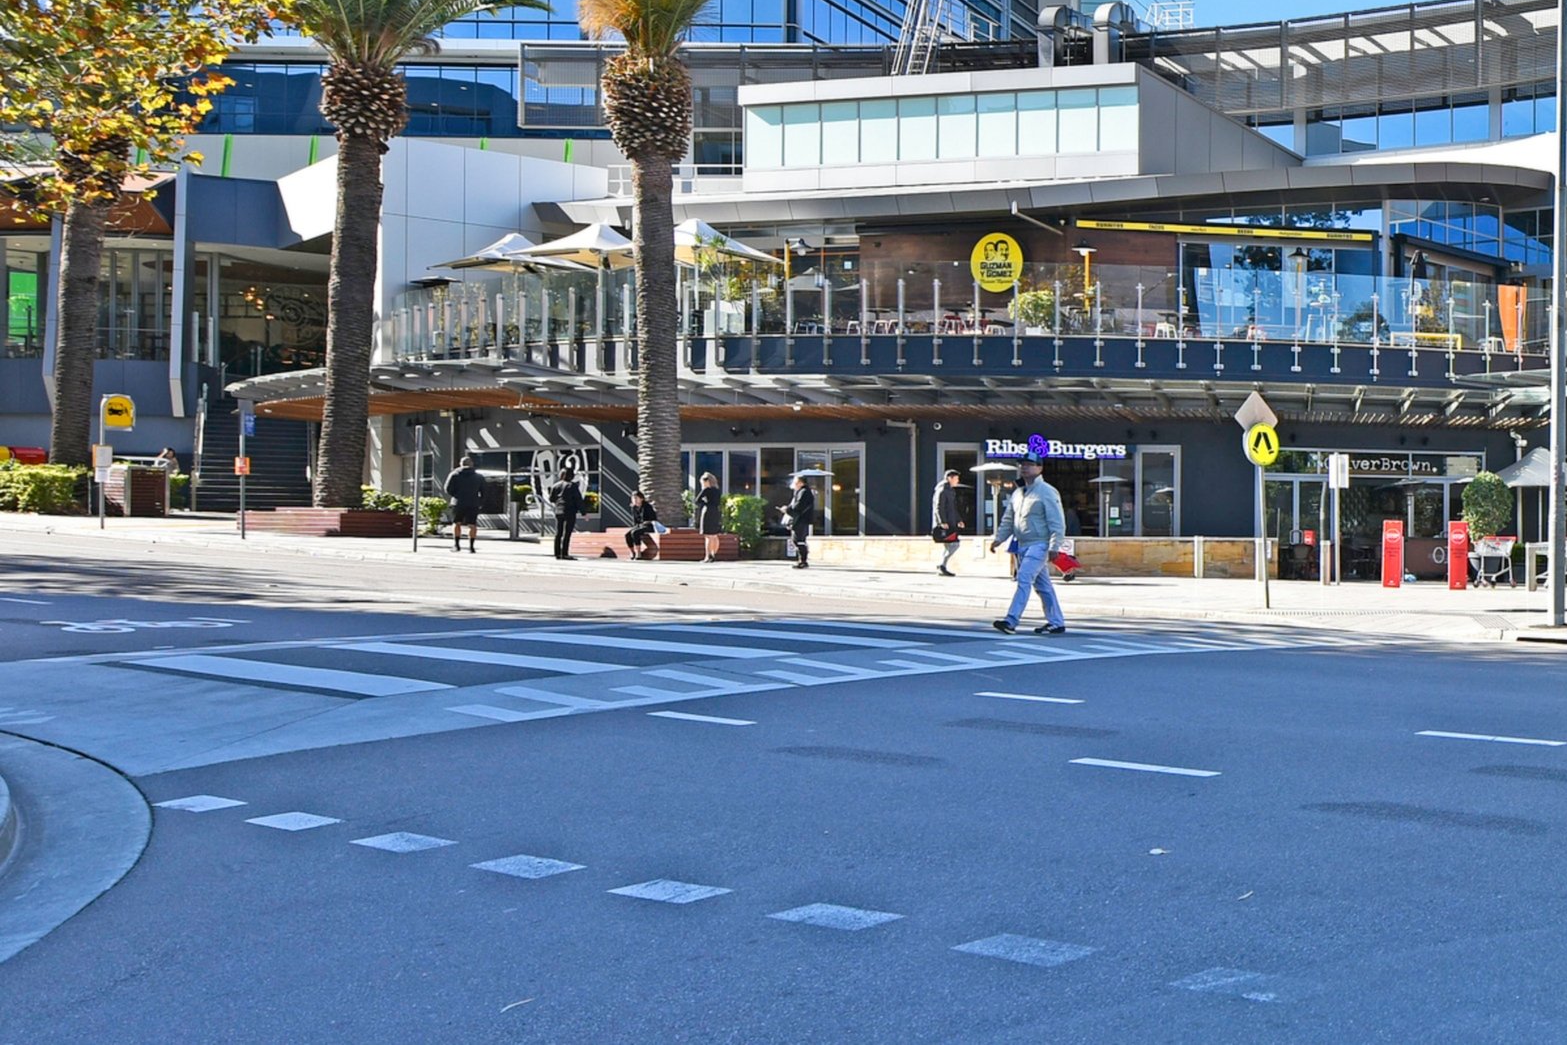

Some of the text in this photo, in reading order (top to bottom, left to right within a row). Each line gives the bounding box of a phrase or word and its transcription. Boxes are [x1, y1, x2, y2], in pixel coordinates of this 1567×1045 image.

[980, 261, 1012, 269] GUZMAN
[985, 433, 1126, 458] Ribs & Burgers
